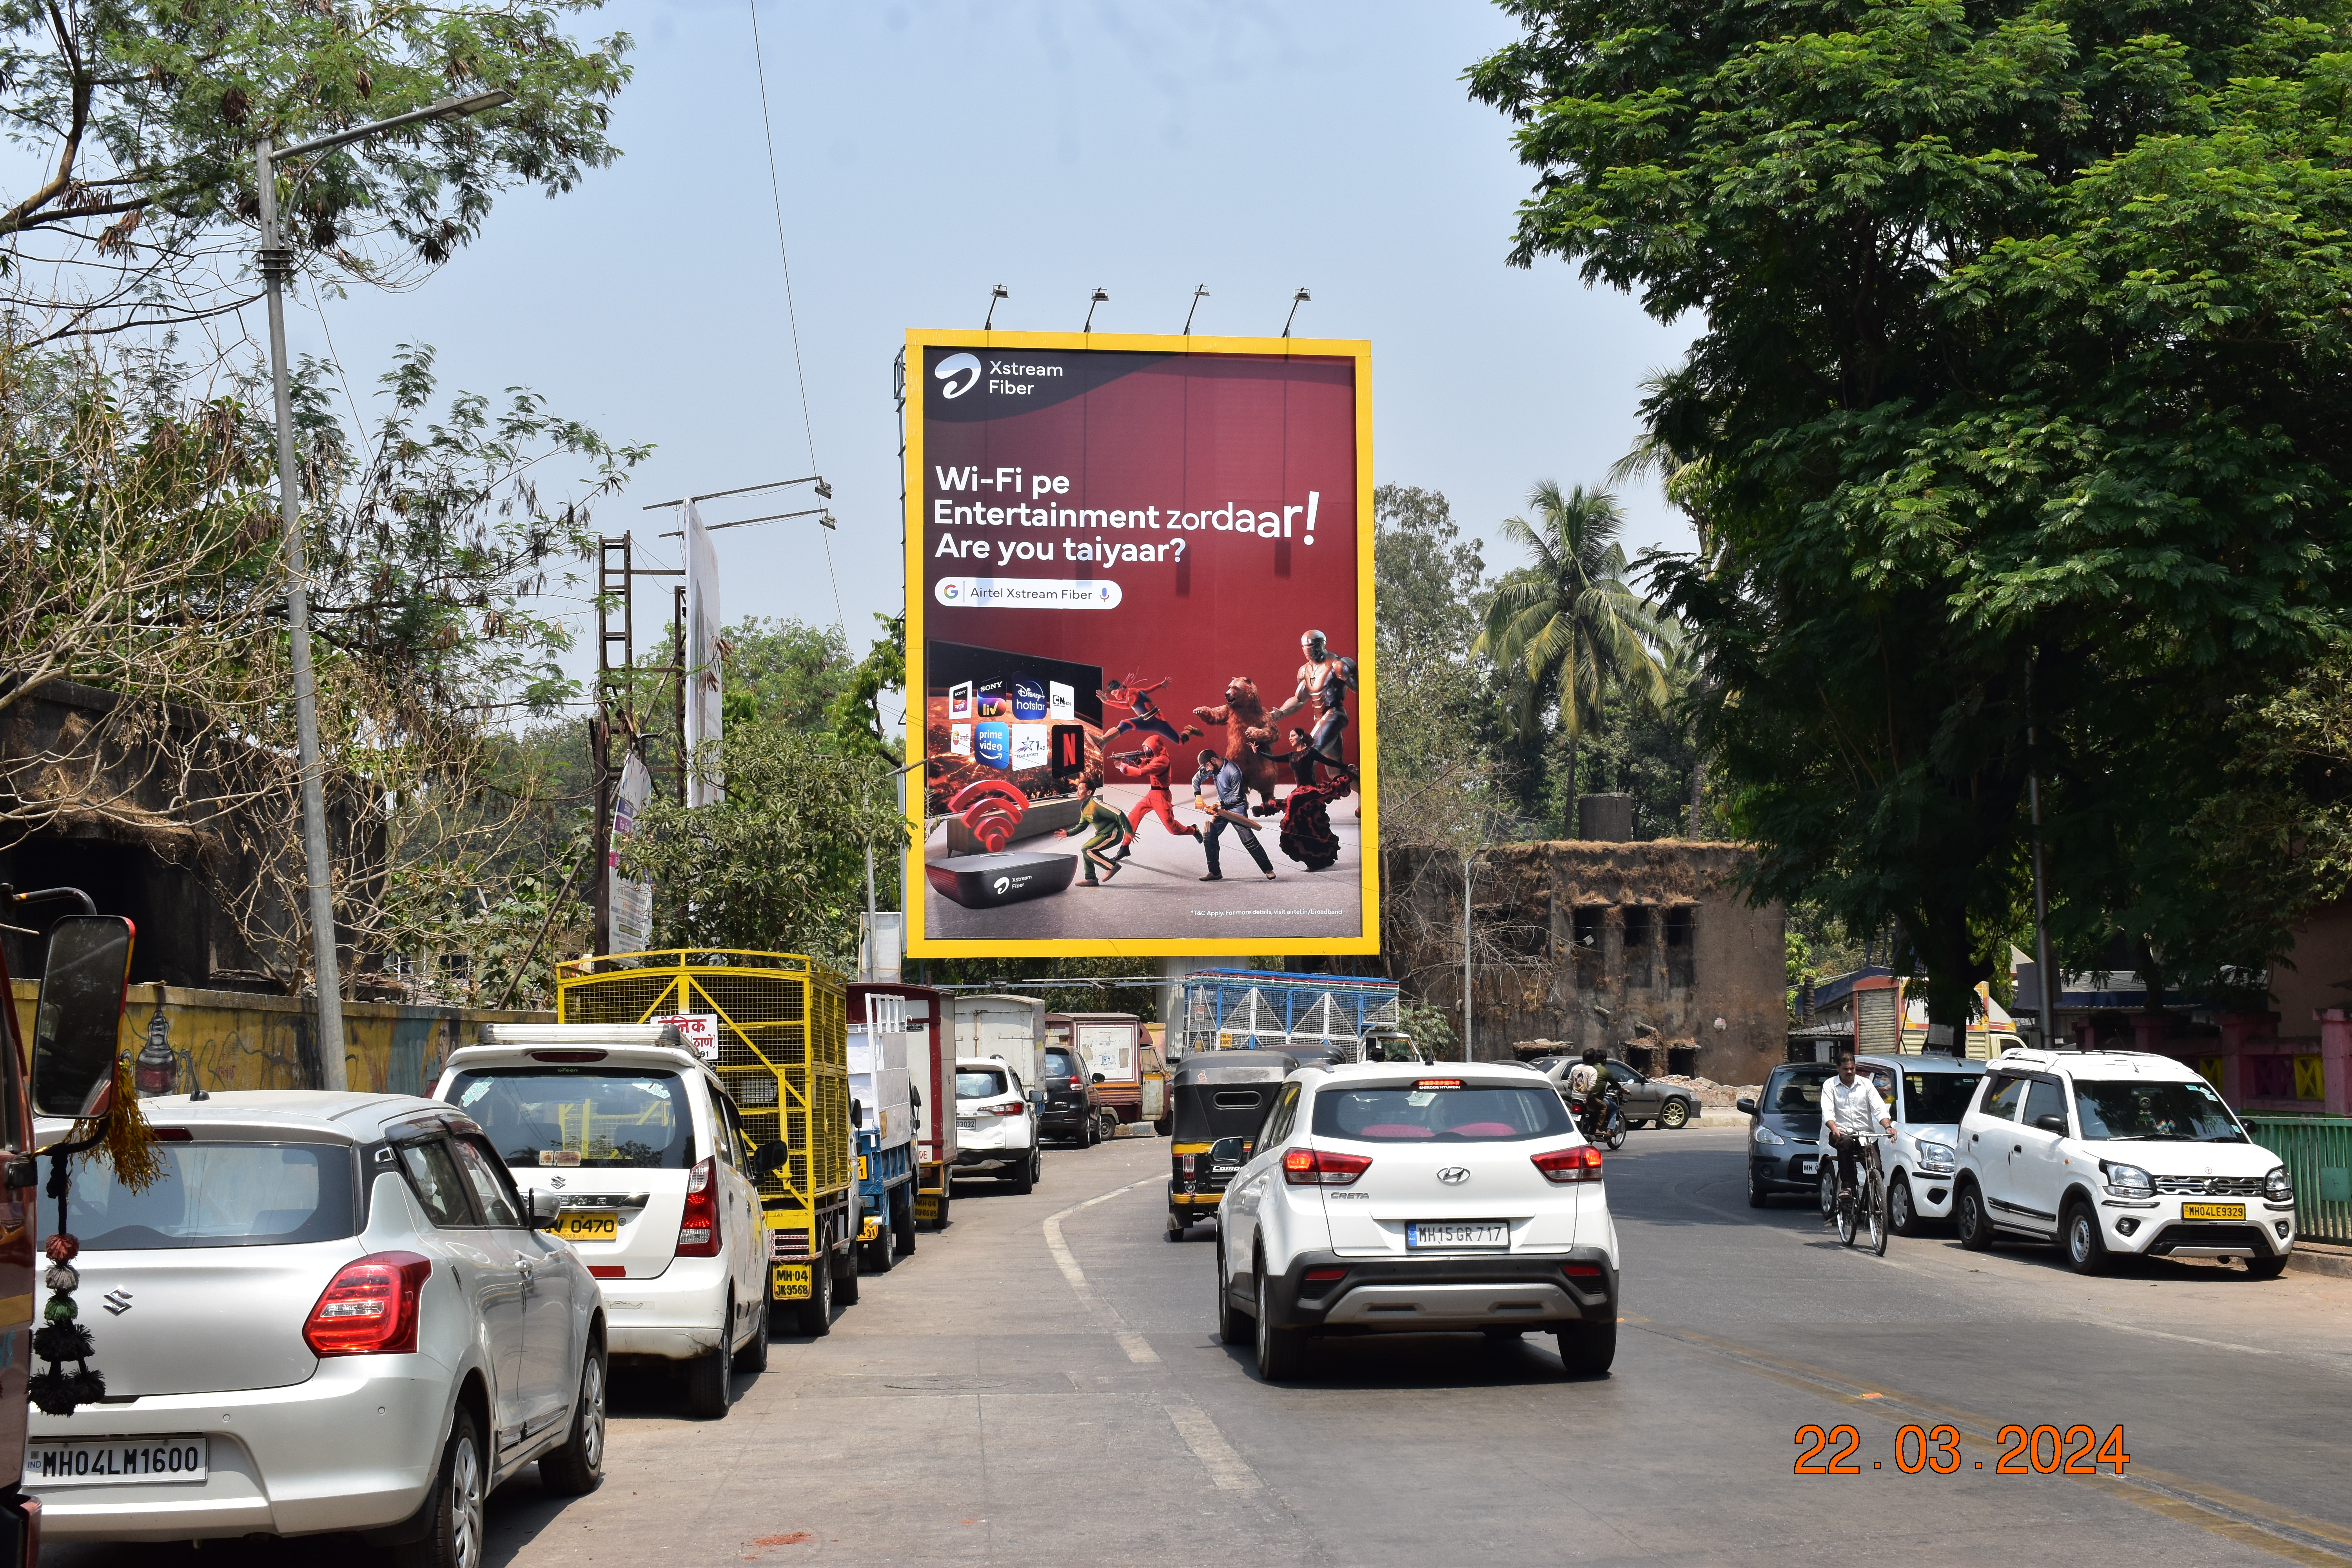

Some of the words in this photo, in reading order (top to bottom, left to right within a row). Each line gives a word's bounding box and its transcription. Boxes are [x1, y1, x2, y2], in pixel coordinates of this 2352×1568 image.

[990, 361, 1063, 376] Xstream
[990, 380, 1034, 394] Fiber
[935, 466, 1022, 492] Wi-Fi
[1033, 475, 1070, 499] pe
[935, 499, 1160, 528] Entertainment
[1167, 491, 1319, 545] zordaar!
[935, 533, 990, 559] Are
[998, 541, 1054, 566] you
[1063, 536, 1186, 568] taiyaar?
[971, 588, 1003, 598] Airtel
[1007, 588, 1057, 599] Xstream
[1062, 589, 1093, 600] Fiber
[980, 681, 1003, 692] SONY
[1016, 700, 1045, 711] hotstar
[979, 730, 1002, 740] prime
[980, 739, 1002, 751] video
[1012, 875, 1032, 883] Xstream
[2189, 1207, 2243, 1216] MH04LE9329
[571, 1219, 614, 1233] 0470
[1477, 1227, 1501, 1241] 717
[43, 1446, 198, 1477] MH04LM1600
